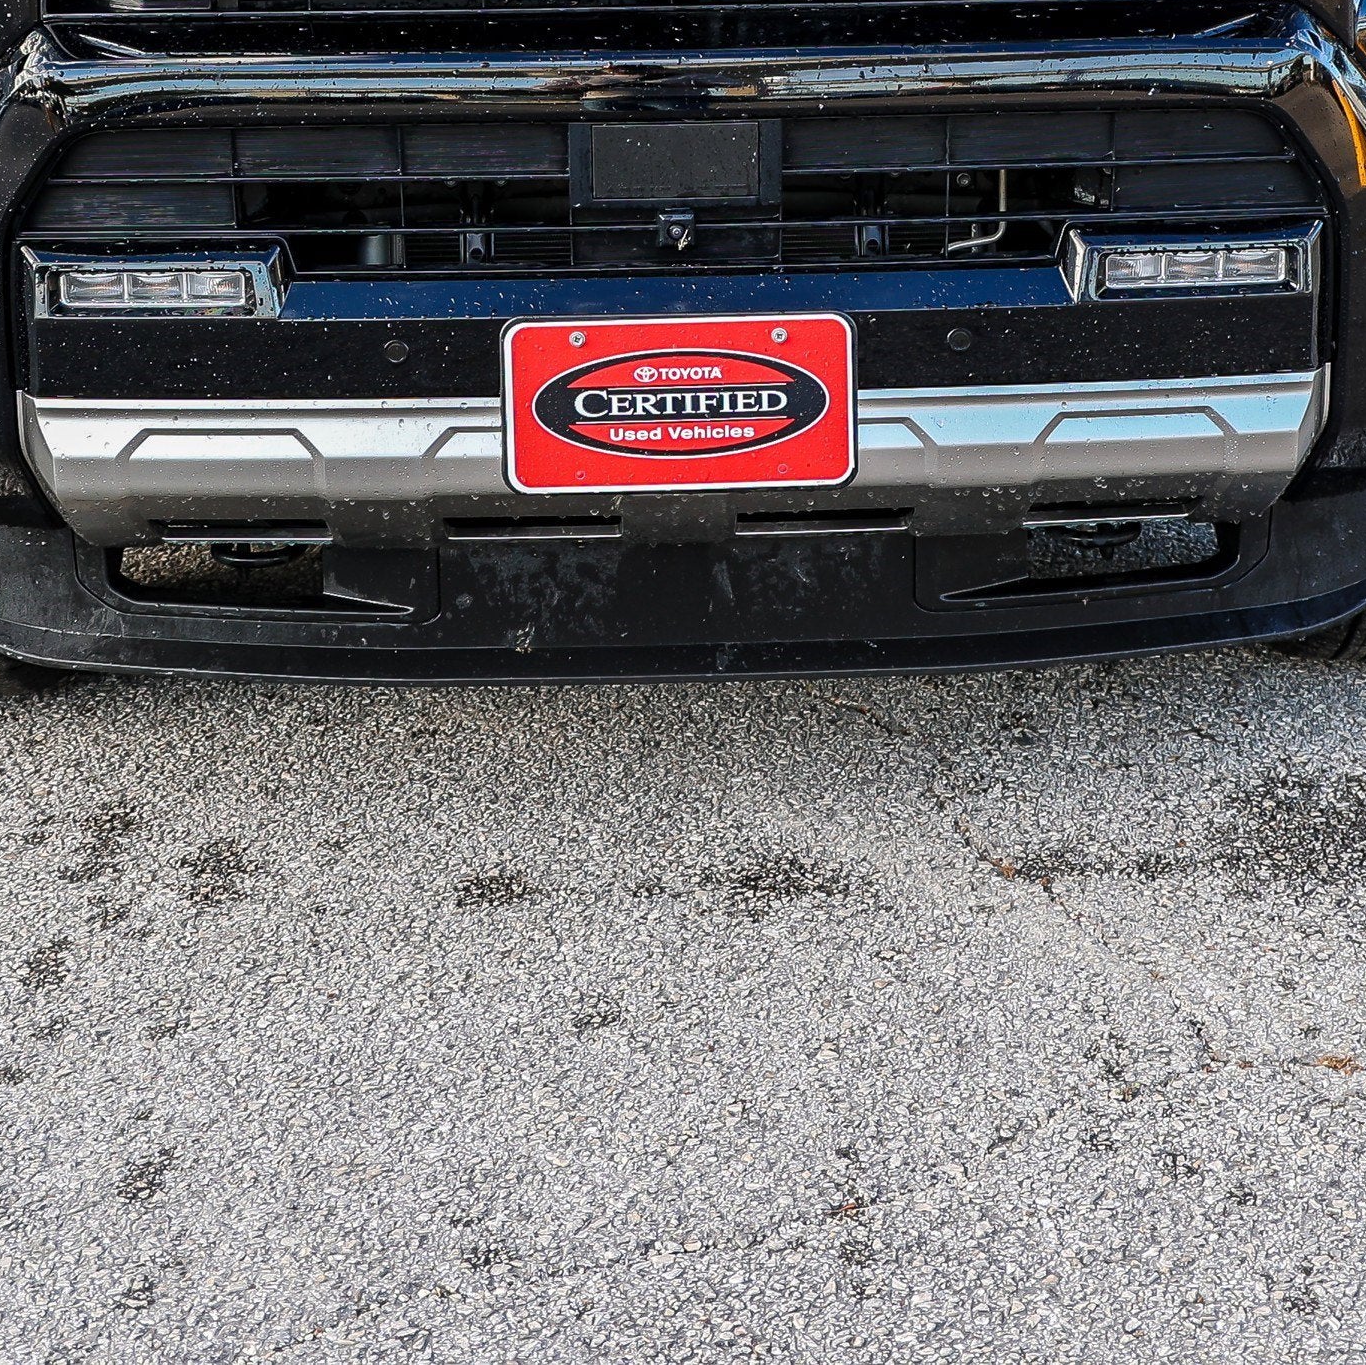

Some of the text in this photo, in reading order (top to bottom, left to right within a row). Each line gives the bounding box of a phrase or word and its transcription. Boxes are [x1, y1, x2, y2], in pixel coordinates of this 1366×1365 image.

[658, 366, 722, 380] TOYOTA
[574, 390, 788, 417] CERTIFIED
[609, 425, 755, 441] Used Vehicles
